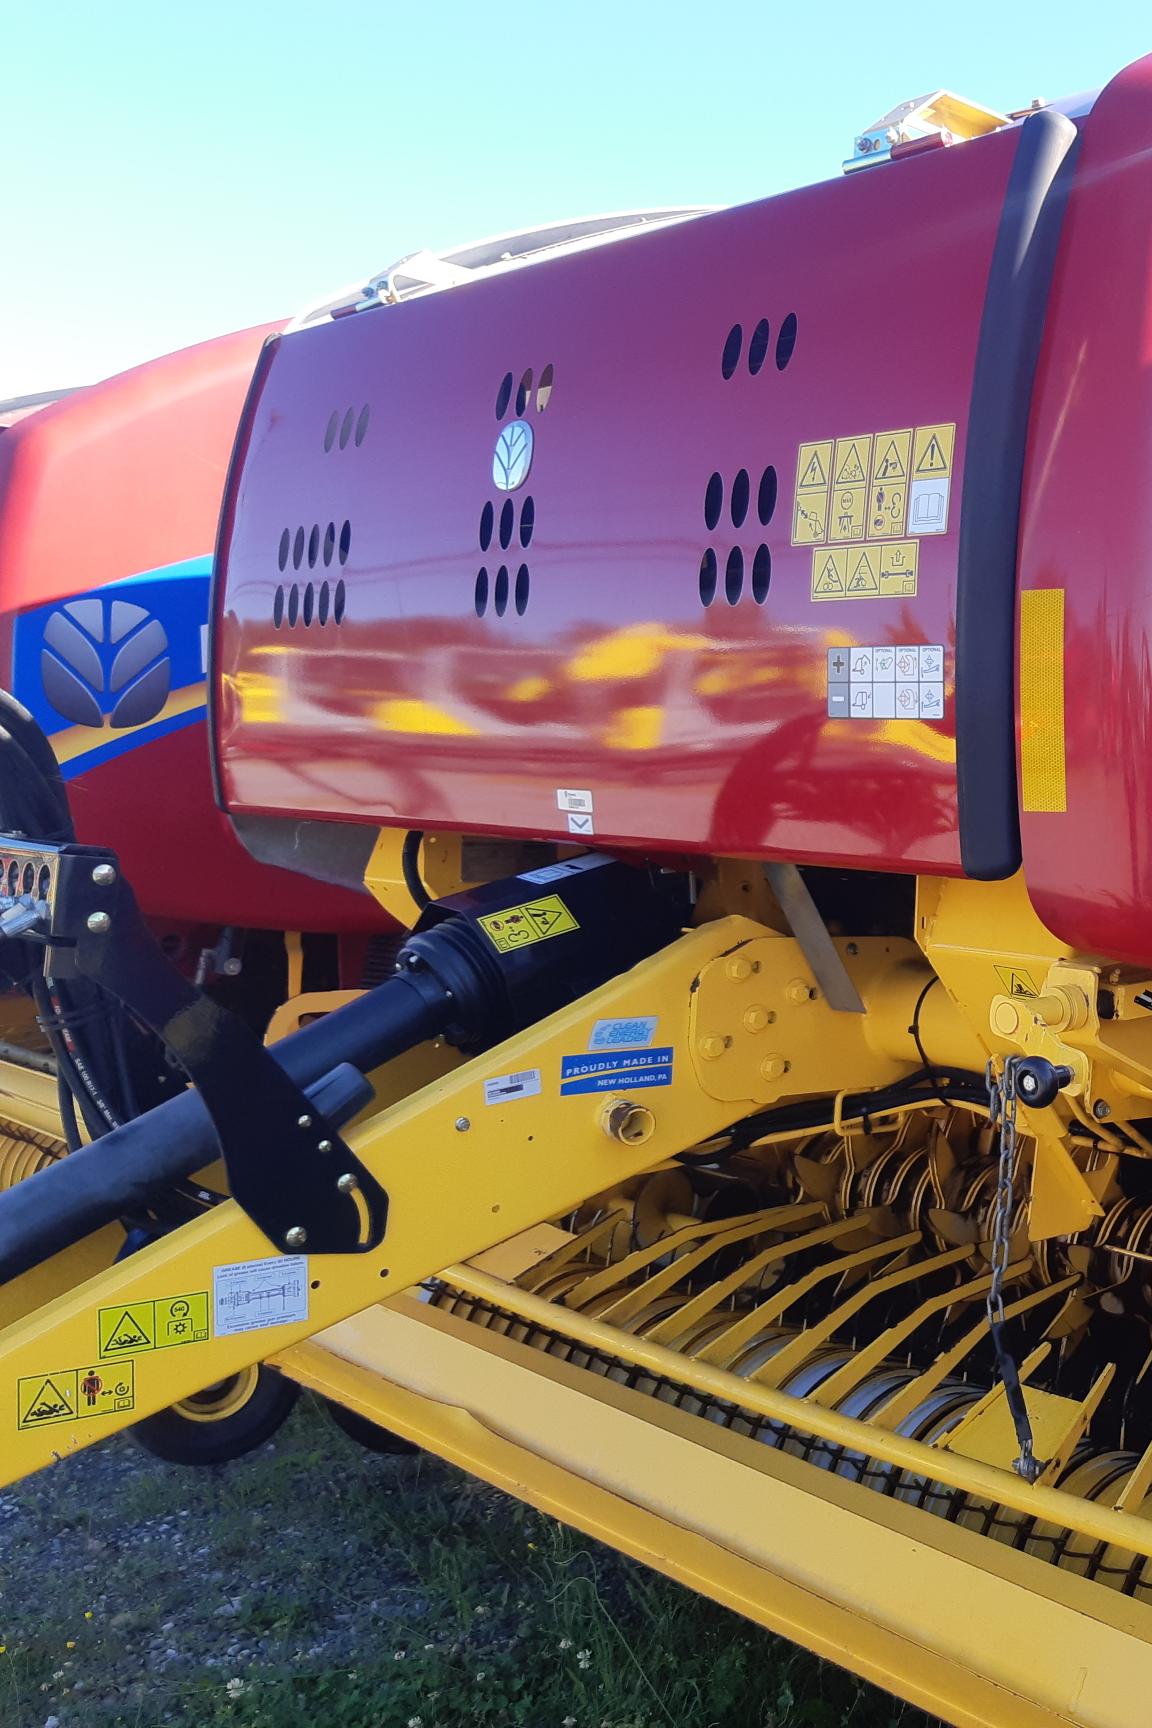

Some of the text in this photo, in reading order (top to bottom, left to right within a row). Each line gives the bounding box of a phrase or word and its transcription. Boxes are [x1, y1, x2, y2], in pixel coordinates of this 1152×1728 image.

[612, 1021, 648, 1030] CLEAN
[606, 1034, 648, 1043] LEADER
[566, 1061, 618, 1076] PROUDLY
[623, 1056, 653, 1066] MADE
[597, 1078, 617, 1086] NEW
